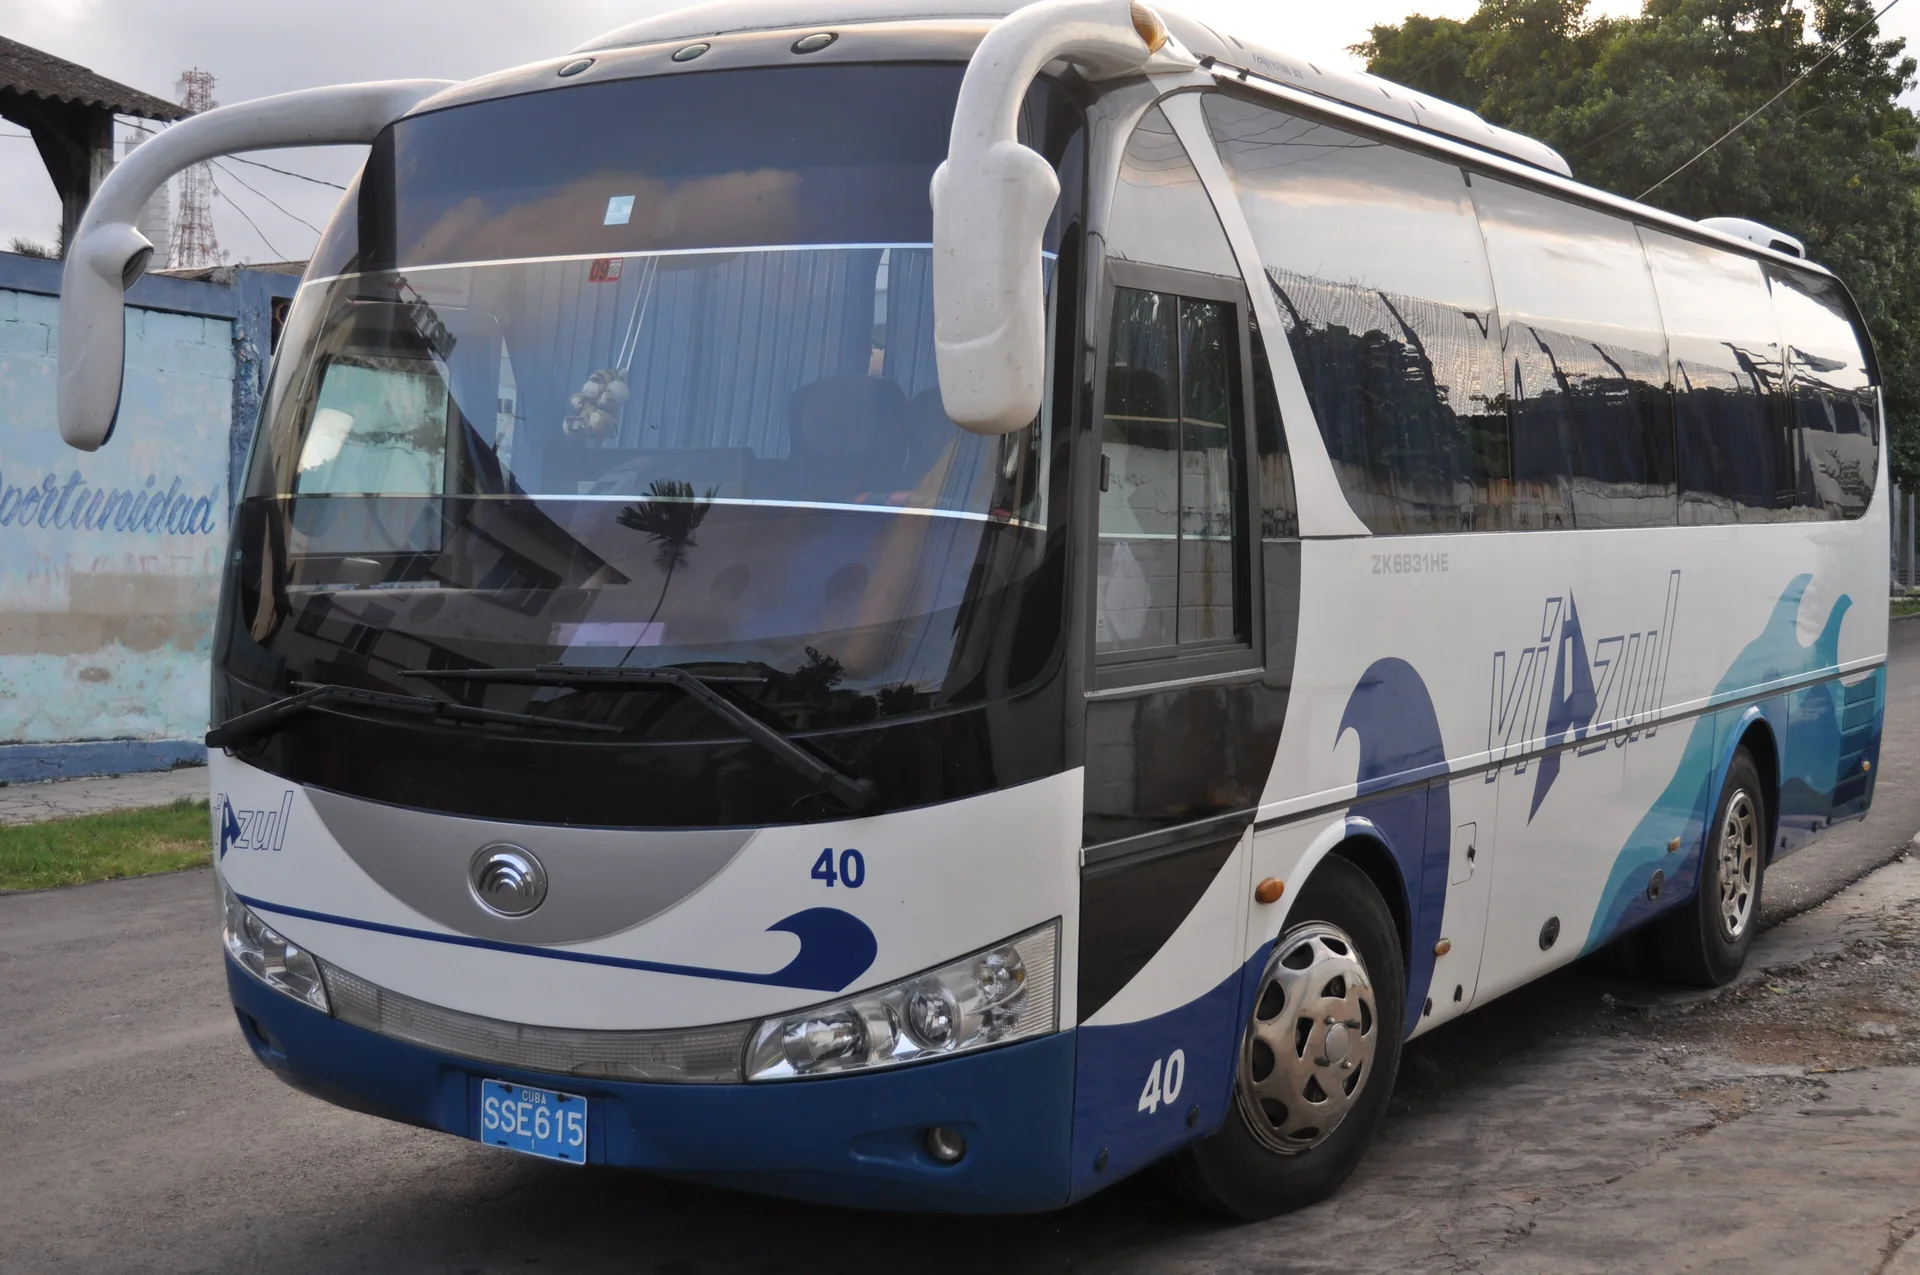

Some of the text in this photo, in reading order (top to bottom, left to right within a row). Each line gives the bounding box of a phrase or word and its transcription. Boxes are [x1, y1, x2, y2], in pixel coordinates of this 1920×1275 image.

[0, 468, 219, 535] portunidad
[1371, 552, 1449, 575] ZK6831HE
[811, 847, 866, 889] 40
[522, 1089, 547, 1105] CUBA
[1138, 1048, 1185, 1115] 40
[484, 1096, 584, 1147] SSE615
